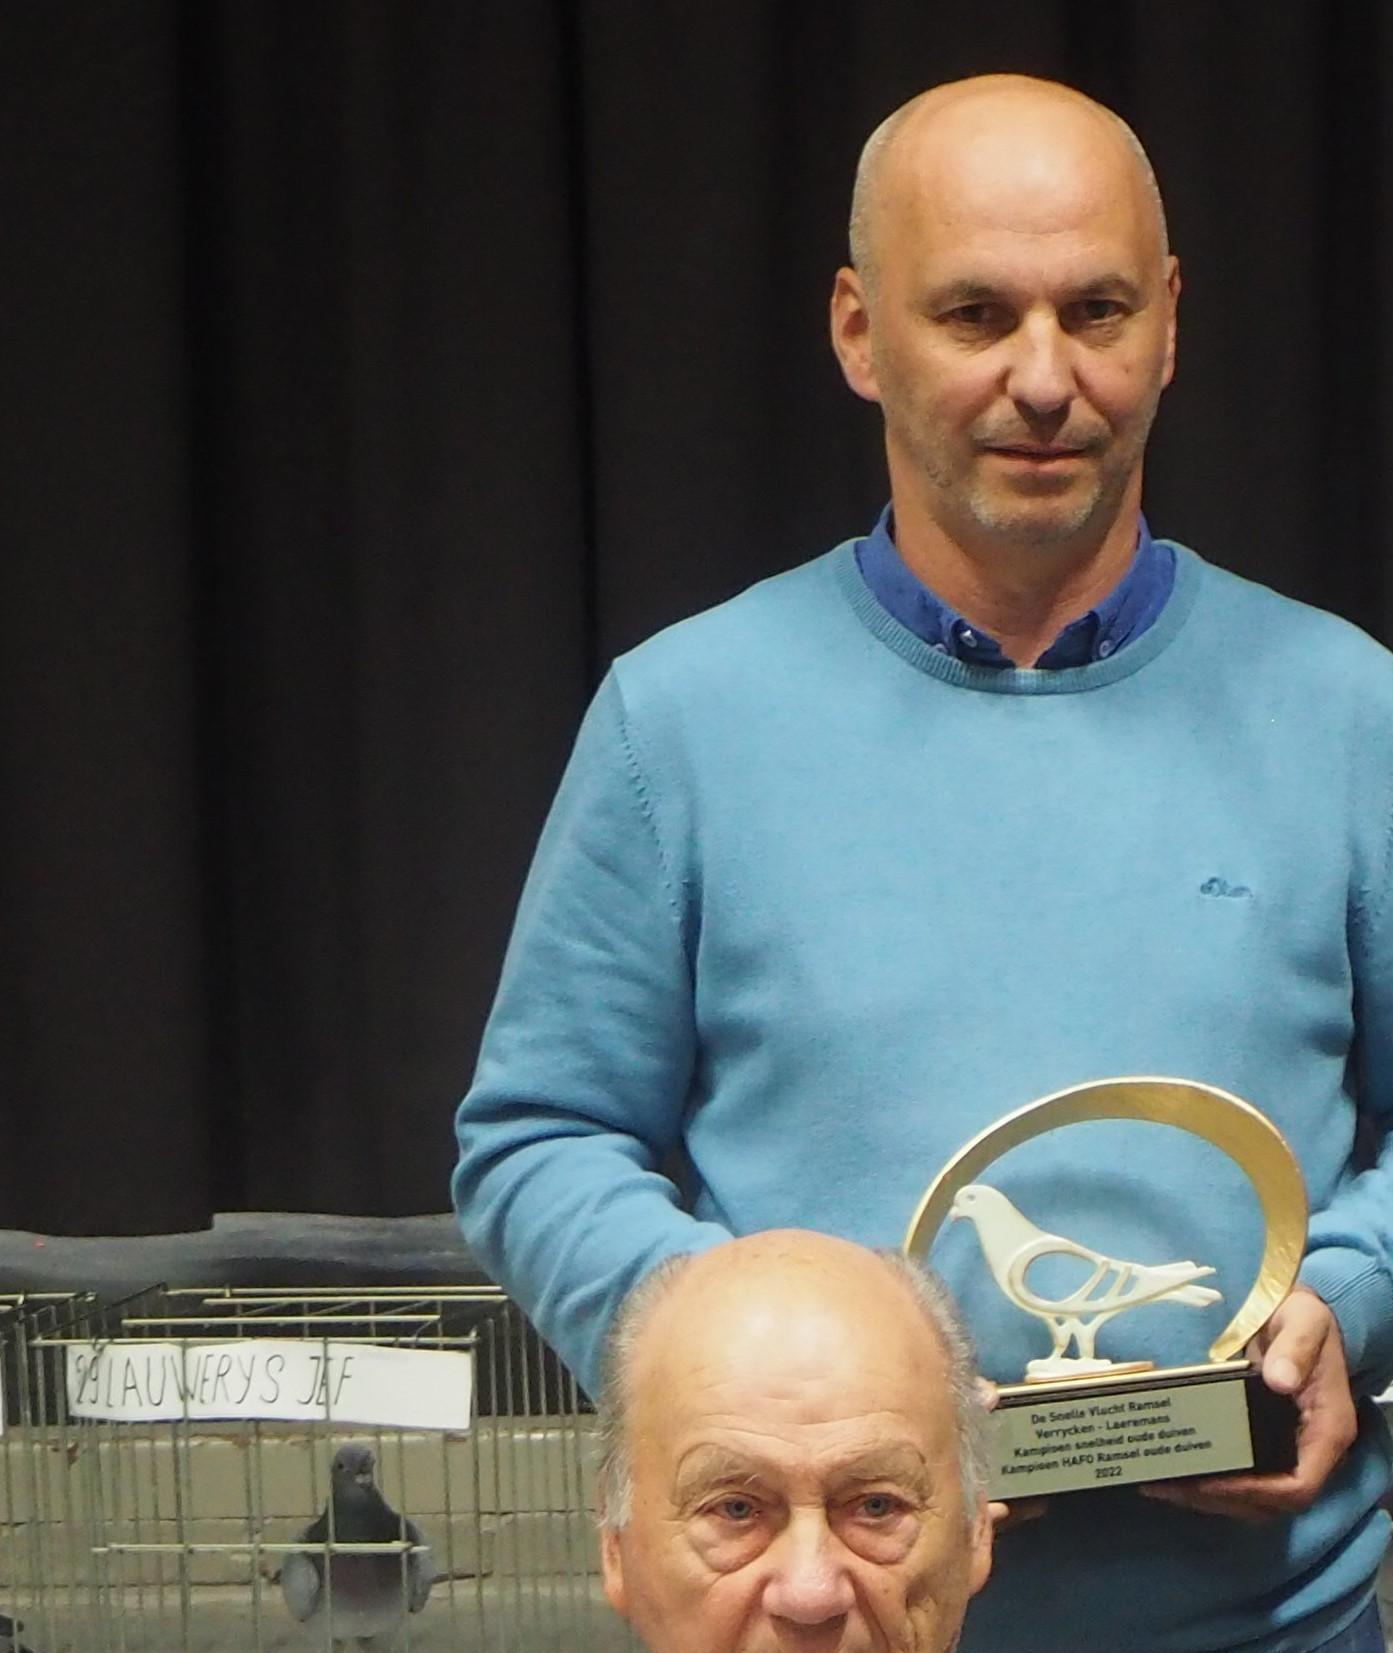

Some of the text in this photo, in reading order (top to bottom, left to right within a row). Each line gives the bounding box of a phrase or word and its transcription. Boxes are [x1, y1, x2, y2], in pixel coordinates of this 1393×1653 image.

[297, 1356, 355, 1405] JEF
[1031, 1413, 1047, 1425] De
[1050, 1409, 1085, 1422] Snelle
[1128, 1397, 1171, 1411] Ramsel
[1001, 1460, 1059, 1476] Kampioen
[1097, 1448, 1141, 1462] Ramsel
[1014, 1443, 1072, 1459] Kampioen
[1095, 1465, 1123, 1479] 2022
